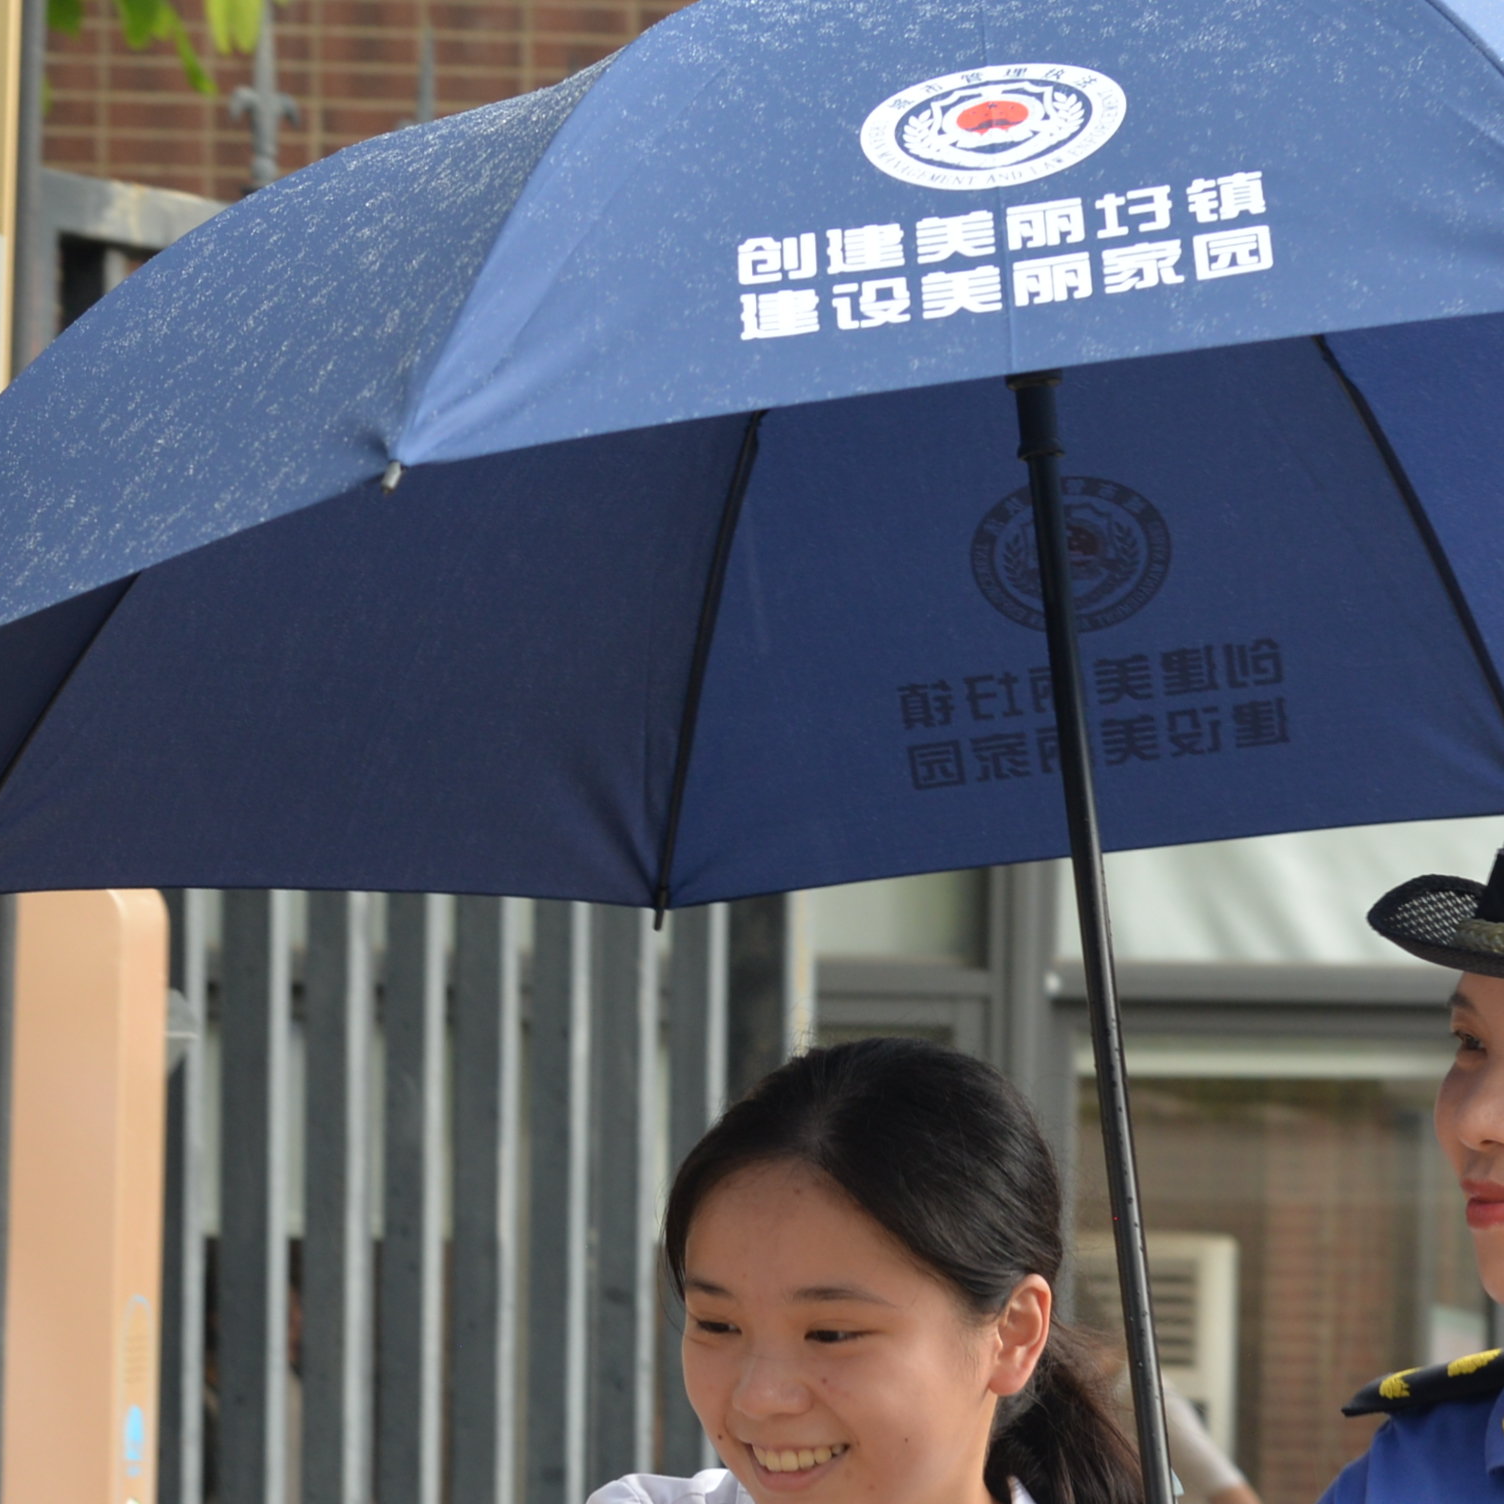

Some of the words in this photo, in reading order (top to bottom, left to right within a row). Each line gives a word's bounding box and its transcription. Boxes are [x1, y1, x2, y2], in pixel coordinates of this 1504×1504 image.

[738, 171, 1266, 285] 创建美丽圩镇
[740, 225, 1273, 340] 建设美丽家园
